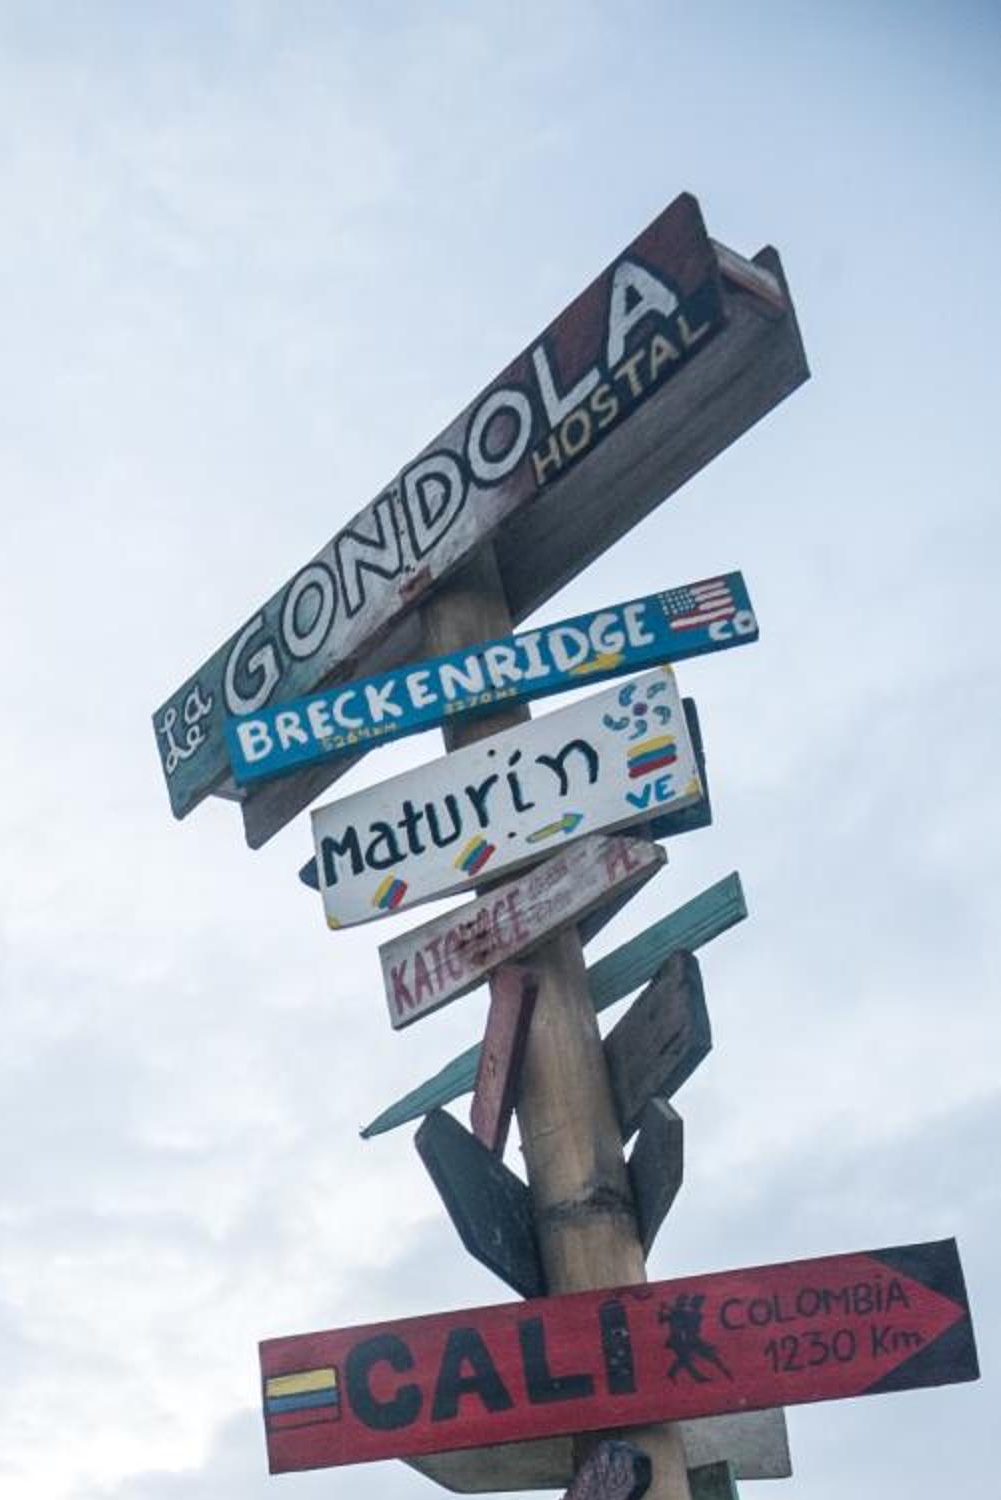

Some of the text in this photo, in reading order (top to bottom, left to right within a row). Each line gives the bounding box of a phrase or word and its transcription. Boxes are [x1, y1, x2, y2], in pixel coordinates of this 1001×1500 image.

[532, 319, 708, 484] HOSTAL
[222, 258, 680, 717] GONDOLA
[236, 603, 756, 764] BRECKENRIDGE CO
[319, 737, 601, 887] Maturín
[625, 774, 676, 812] VE
[344, 1299, 638, 1431] CALI
[764, 1328, 856, 1373] 1230
